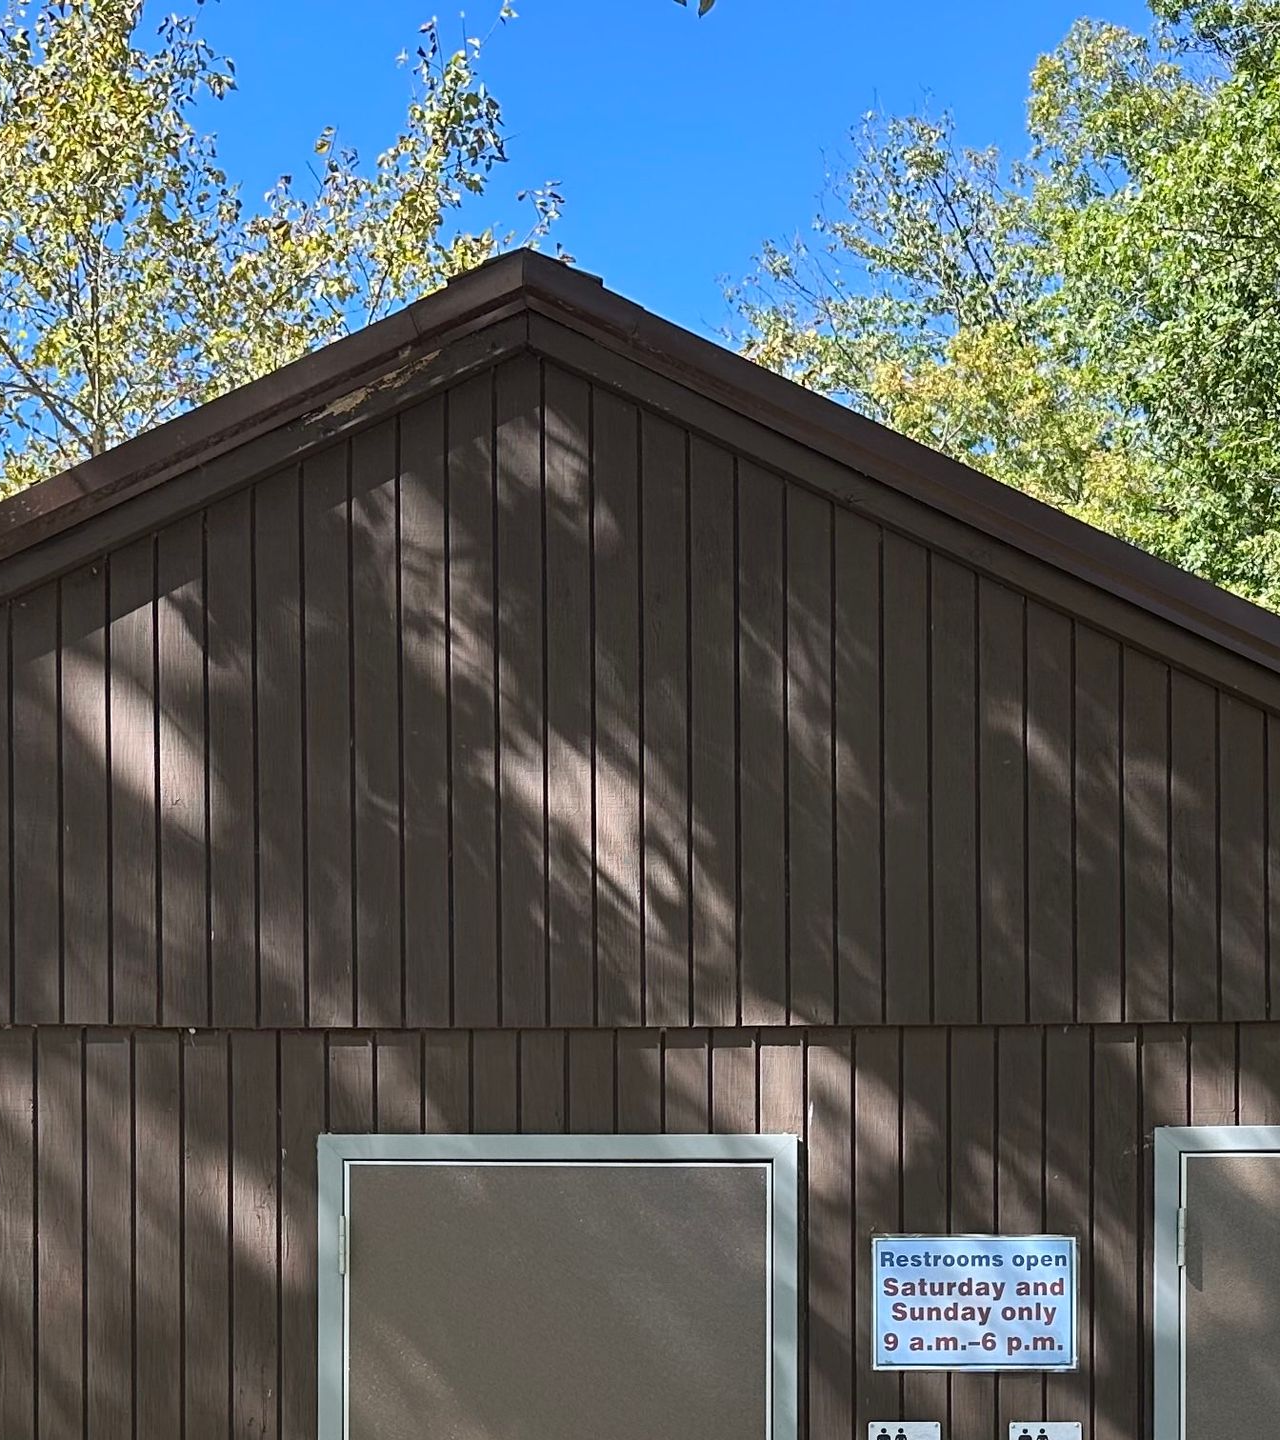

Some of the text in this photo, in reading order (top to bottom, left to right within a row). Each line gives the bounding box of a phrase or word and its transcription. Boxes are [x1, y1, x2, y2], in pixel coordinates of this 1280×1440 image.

[880, 1251, 1068, 1271] Restrooms open
[883, 1277, 1065, 1301] Saturday and
[891, 1302, 1058, 1326] Sunday only
[883, 1332, 899, 1352] 9
[1006, 1335, 1064, 1356] p.m.
